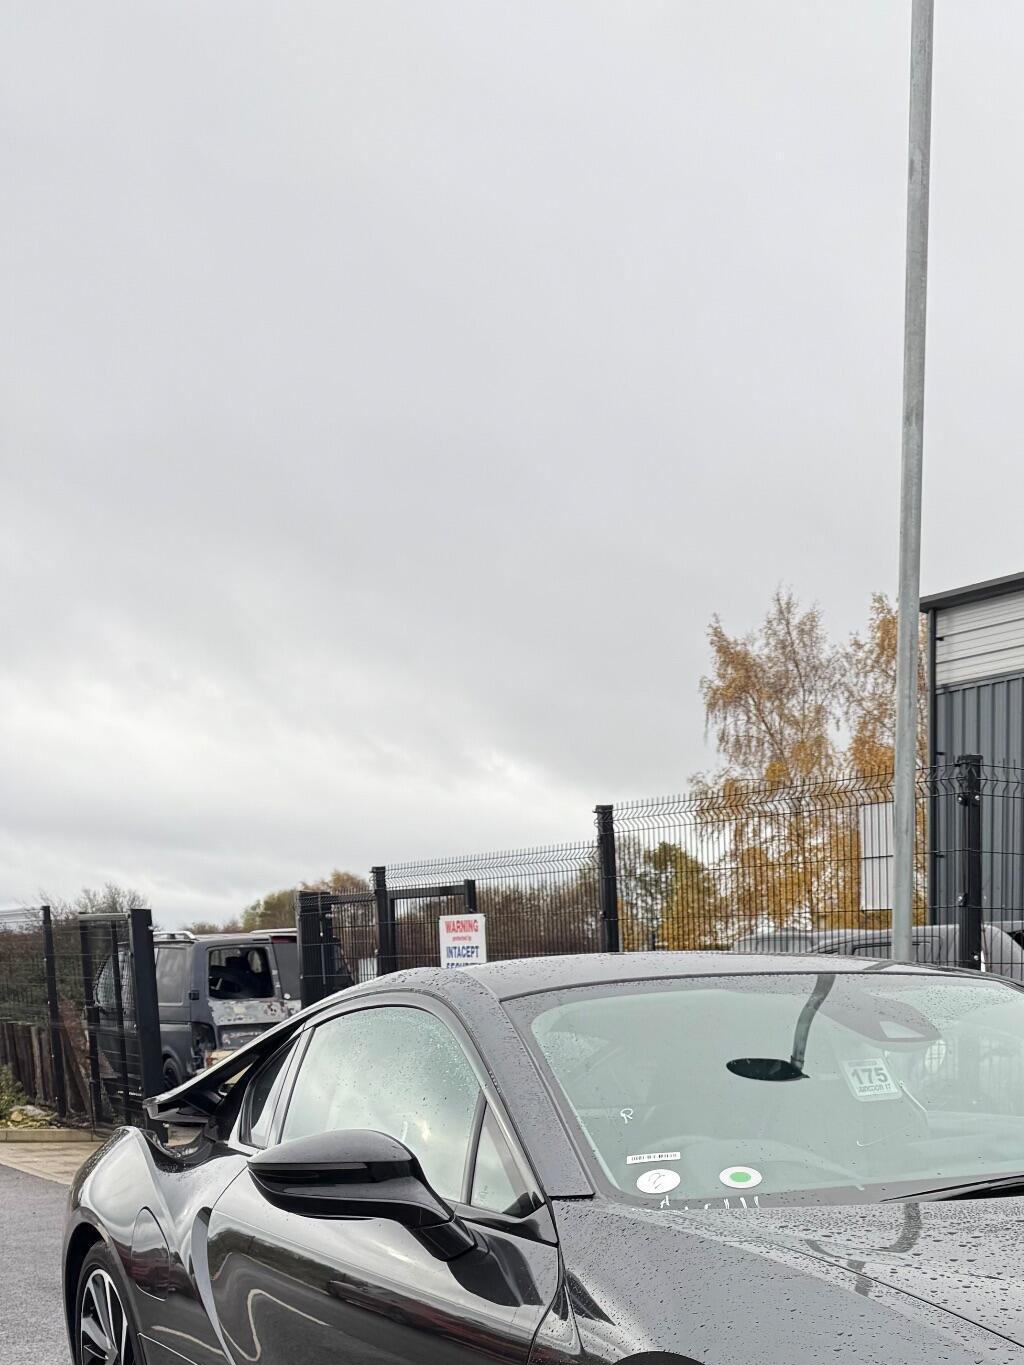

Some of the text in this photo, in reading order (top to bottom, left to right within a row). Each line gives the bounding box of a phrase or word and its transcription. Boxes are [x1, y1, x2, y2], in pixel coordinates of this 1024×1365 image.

[444, 919, 479, 933] WARNING
[446, 945, 480, 959] INTACEPT
[851, 1067, 888, 1085] 175
